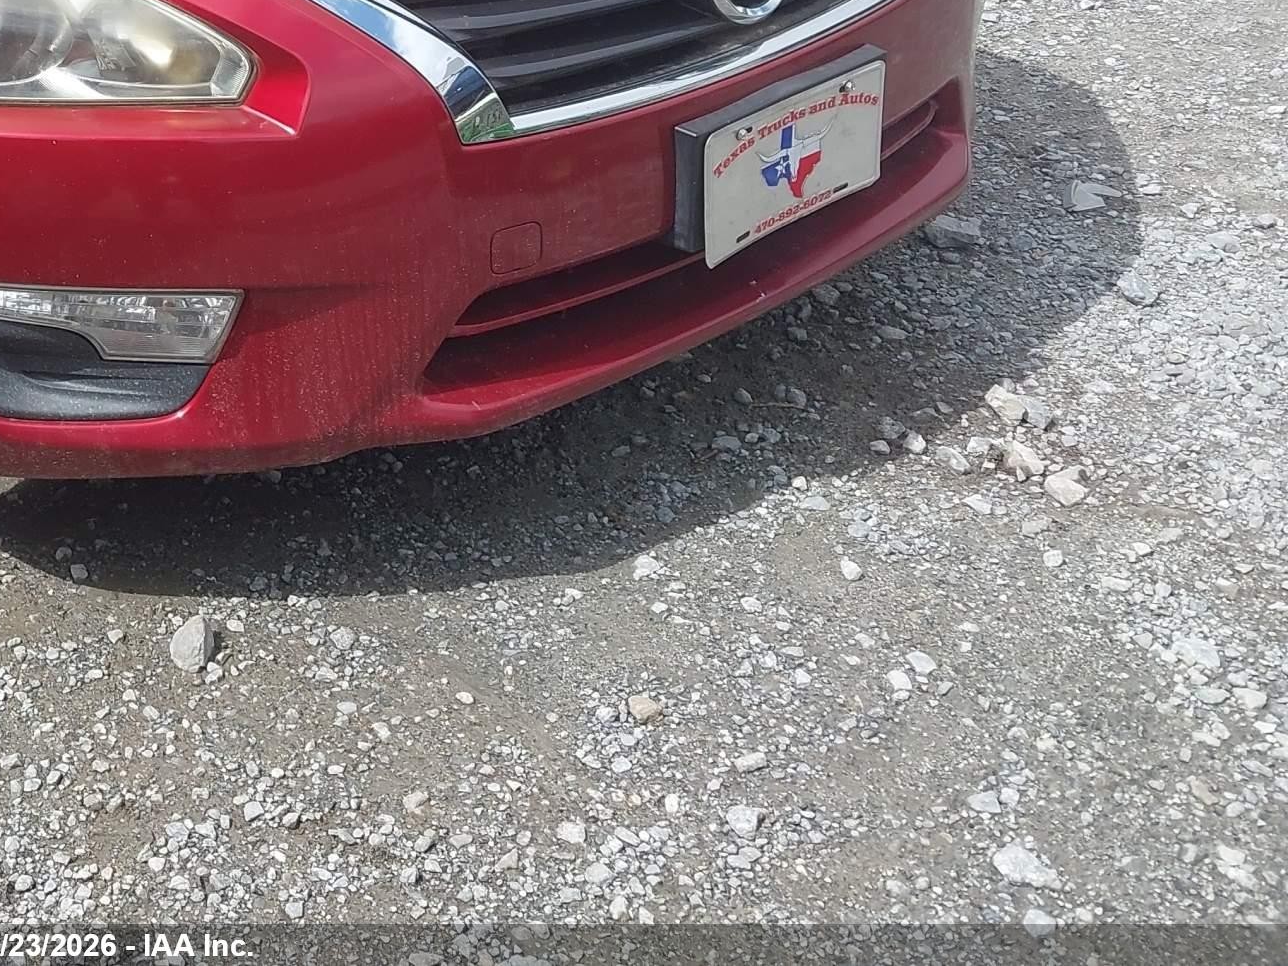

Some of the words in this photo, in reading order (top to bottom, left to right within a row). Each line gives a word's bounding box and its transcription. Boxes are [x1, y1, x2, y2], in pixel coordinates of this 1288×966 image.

[713, 136, 756, 179] Texas
[757, 107, 806, 140] Trucks
[807, 96, 837, 115] and
[838, 92, 880, 107] Autos
[755, 190, 832, 234] 470-892-6072
